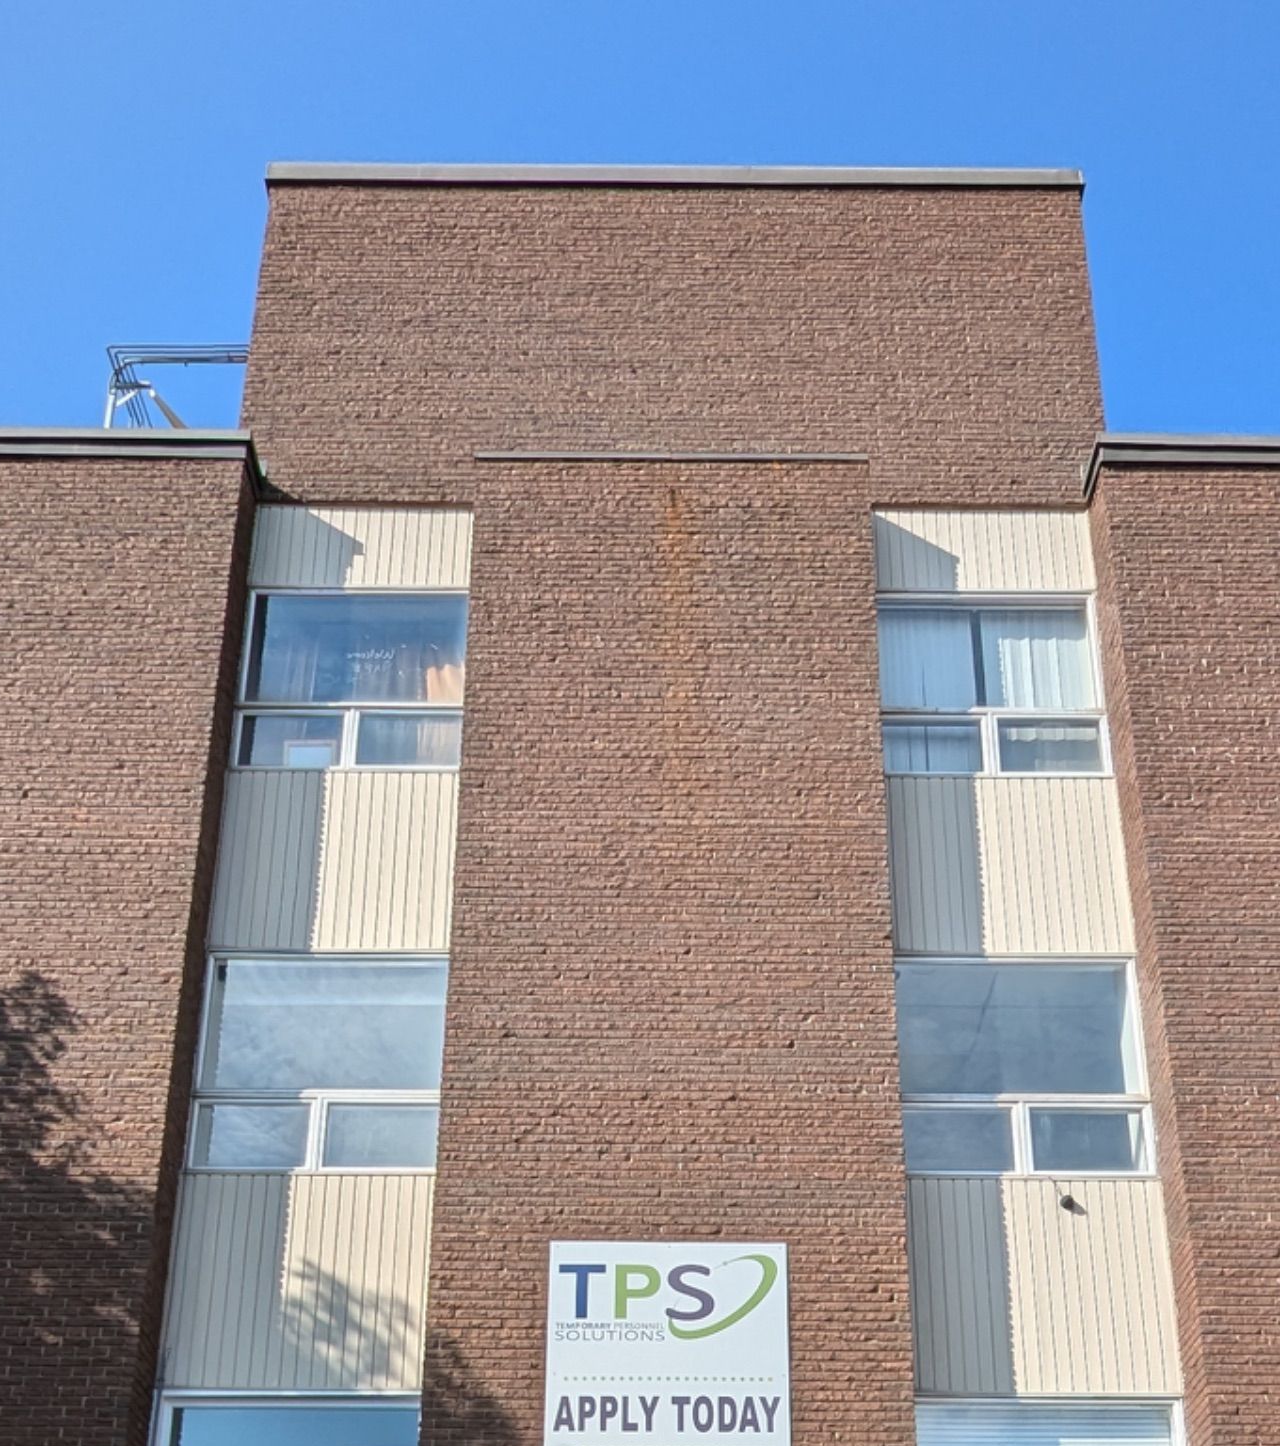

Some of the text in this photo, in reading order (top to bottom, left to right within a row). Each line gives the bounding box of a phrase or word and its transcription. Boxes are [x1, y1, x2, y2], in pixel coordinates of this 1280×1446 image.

[558, 1264, 715, 1321] TPS
[554, 1330, 665, 1341] SOLUTIONS
[553, 1396, 780, 1433] APPLY TODAY
